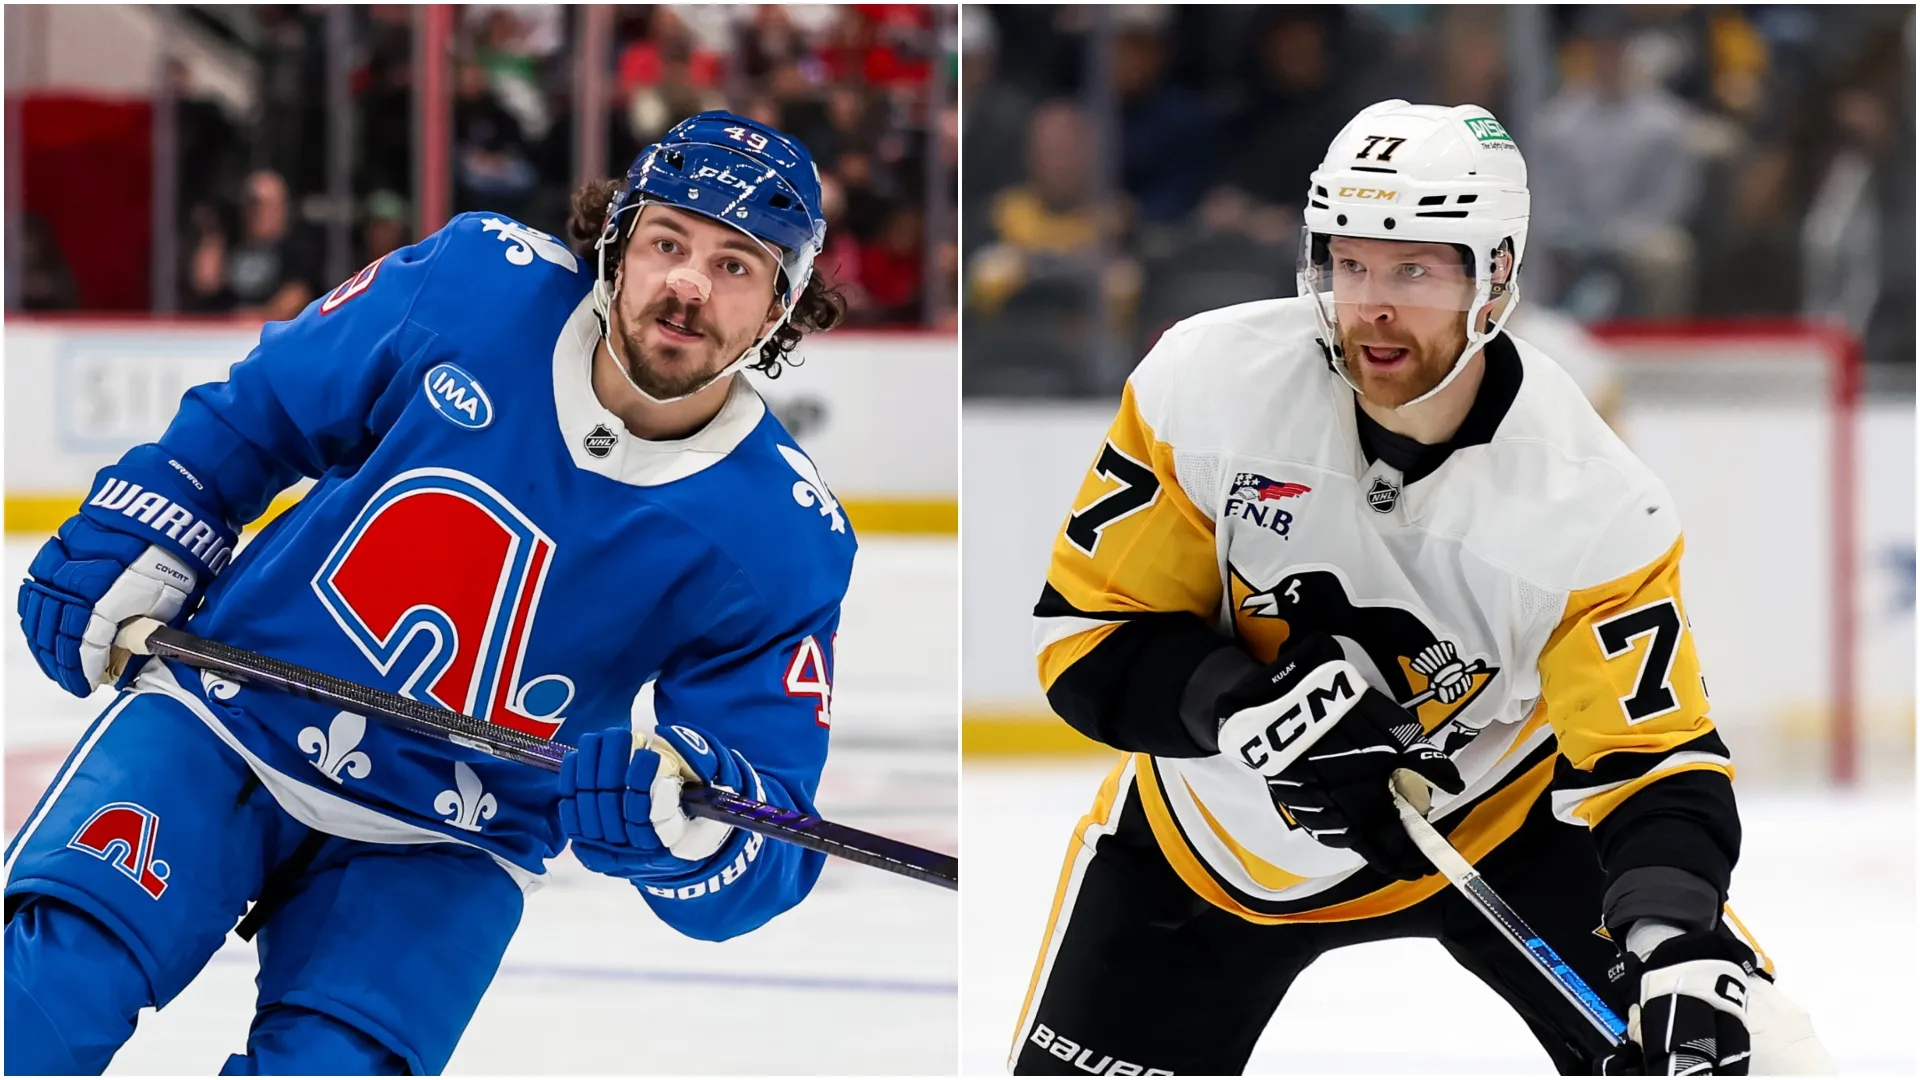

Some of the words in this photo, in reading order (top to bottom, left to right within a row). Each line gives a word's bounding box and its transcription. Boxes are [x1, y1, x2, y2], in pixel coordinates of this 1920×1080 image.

[723, 126, 769, 151] 49
[1355, 135, 1407, 162] 77
[698, 165, 757, 195] CCM
[1339, 187, 1397, 201] CCM
[432, 371, 479, 421] IMA
[588, 438, 611, 446] NHL
[168, 459, 204, 491] GIRARD
[1371, 491, 1394, 503] NHL
[155, 562, 189, 584] COVERT
[1271, 661, 1297, 684] KULAK
[1591, 595, 1709, 727] 7
[782, 631, 838, 730] 4
[1240, 670, 1356, 770] CCM
[645, 832, 763, 900] RRIOR
